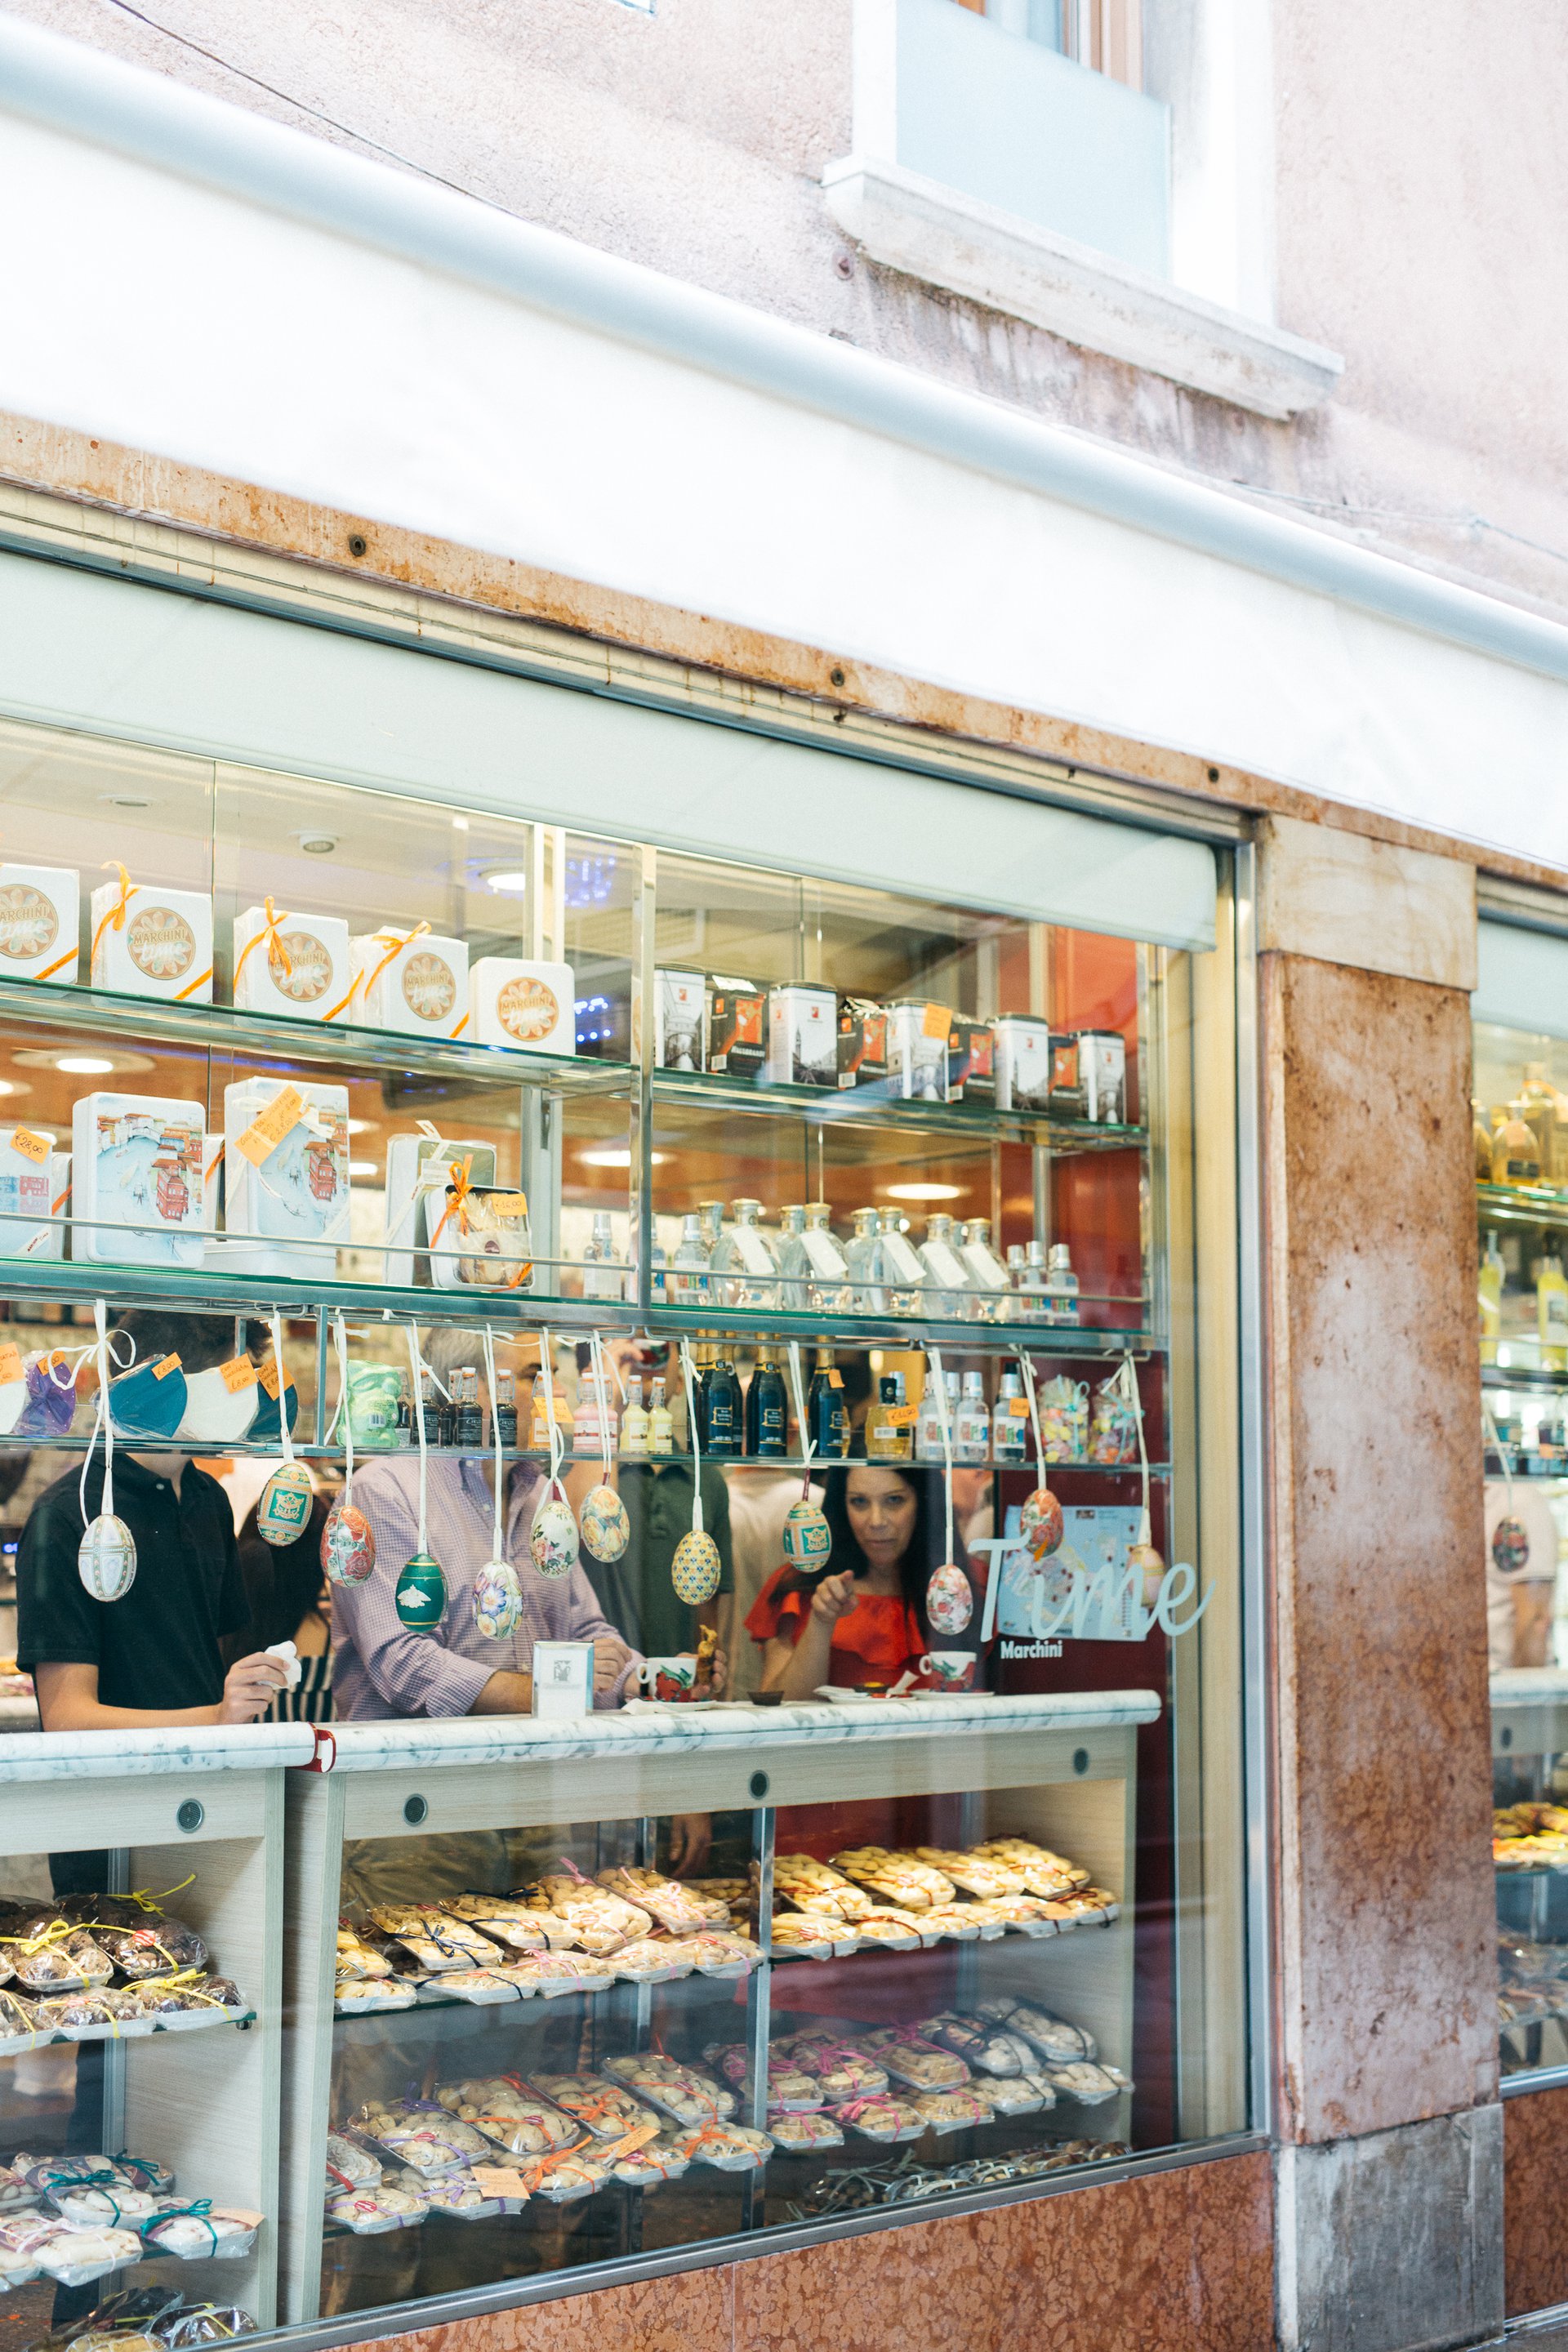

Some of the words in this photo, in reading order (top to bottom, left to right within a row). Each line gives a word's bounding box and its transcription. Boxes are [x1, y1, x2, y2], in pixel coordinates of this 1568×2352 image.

[0, 906, 47, 922] ARCHINI
[132, 929, 185, 946] MARCHINI
[407, 973, 449, 987] MARCHINI
[501, 997, 550, 1011] MARCHINI
[15, 1133, 43, 1155] €28,00
[157, 1361, 176, 1377] €8,00
[968, 1529, 1216, 1643] Time
[1000, 1640, 1063, 1659] Marchini
